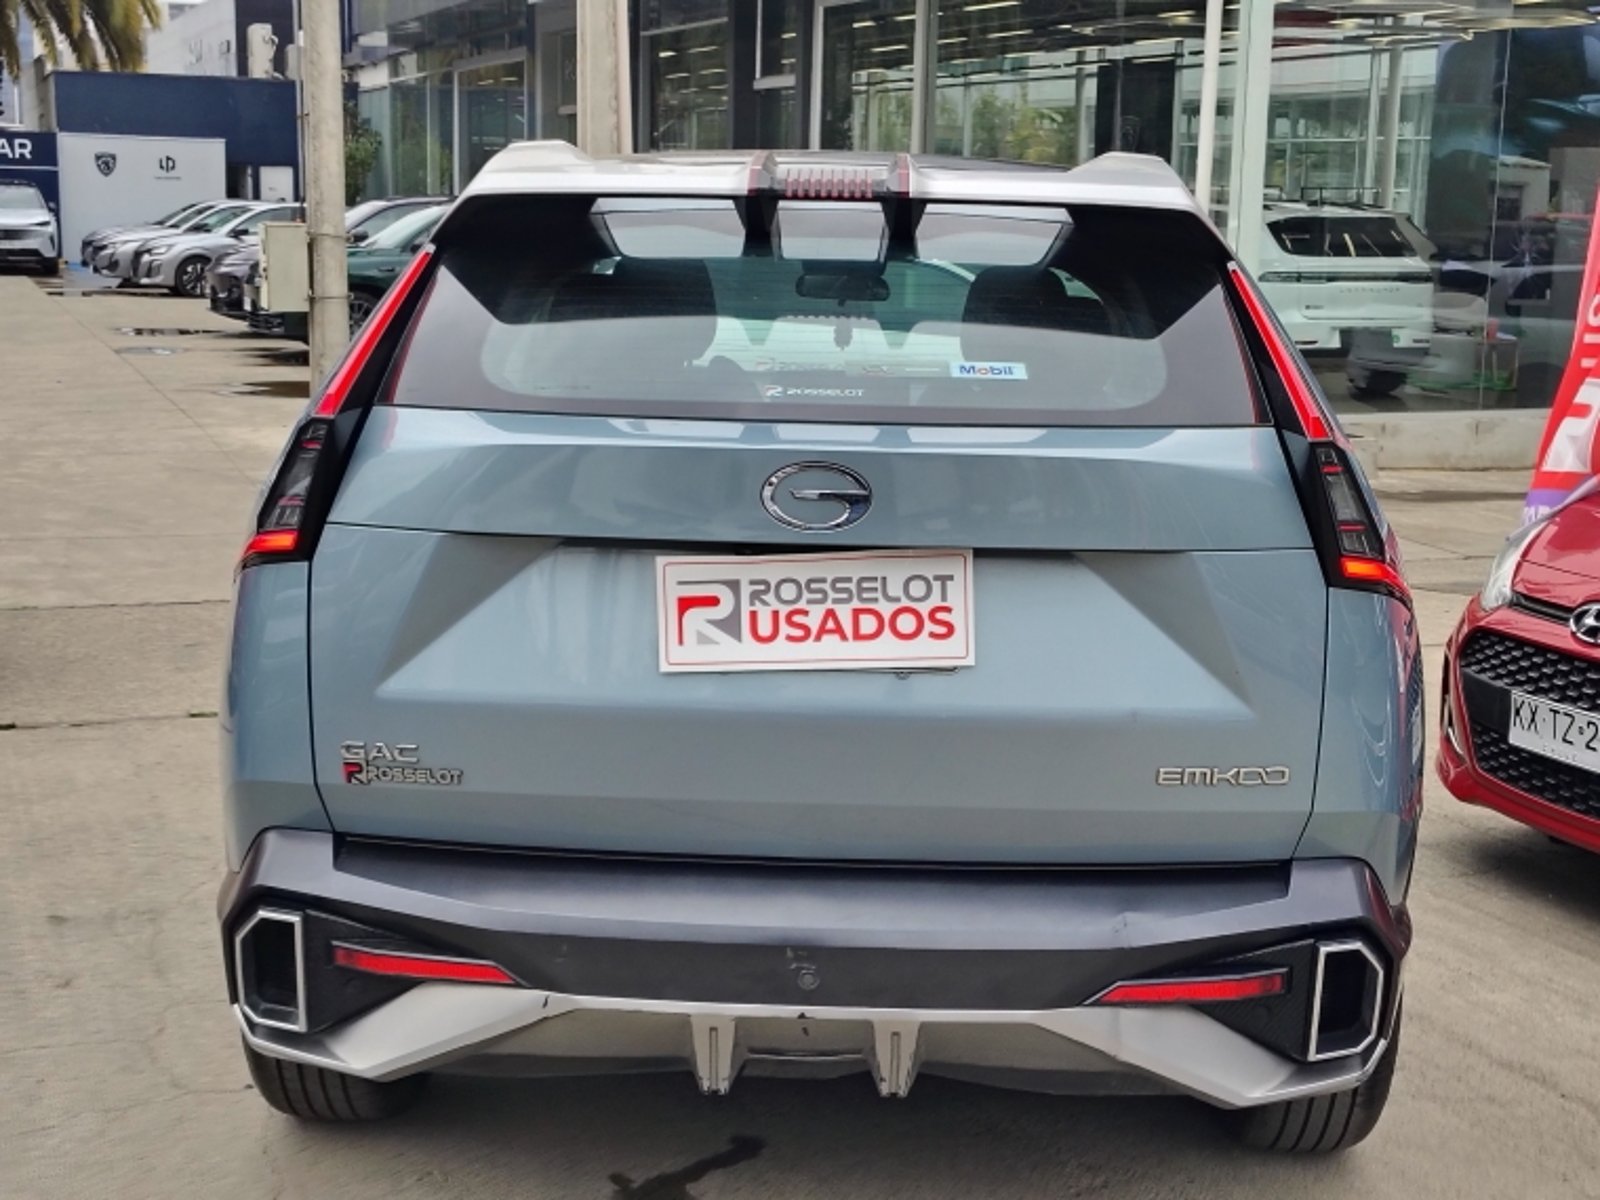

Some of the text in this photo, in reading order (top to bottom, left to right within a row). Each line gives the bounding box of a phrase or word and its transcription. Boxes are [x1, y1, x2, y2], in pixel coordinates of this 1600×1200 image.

[959, 365, 1013, 375] Mobil
[749, 574, 954, 606] ROSSELOT
[749, 605, 956, 644] USADOS
[340, 740, 419, 762] GAC
[367, 766, 463, 785] ROSSELOT
[1157, 766, 1290, 785] EMKOO
